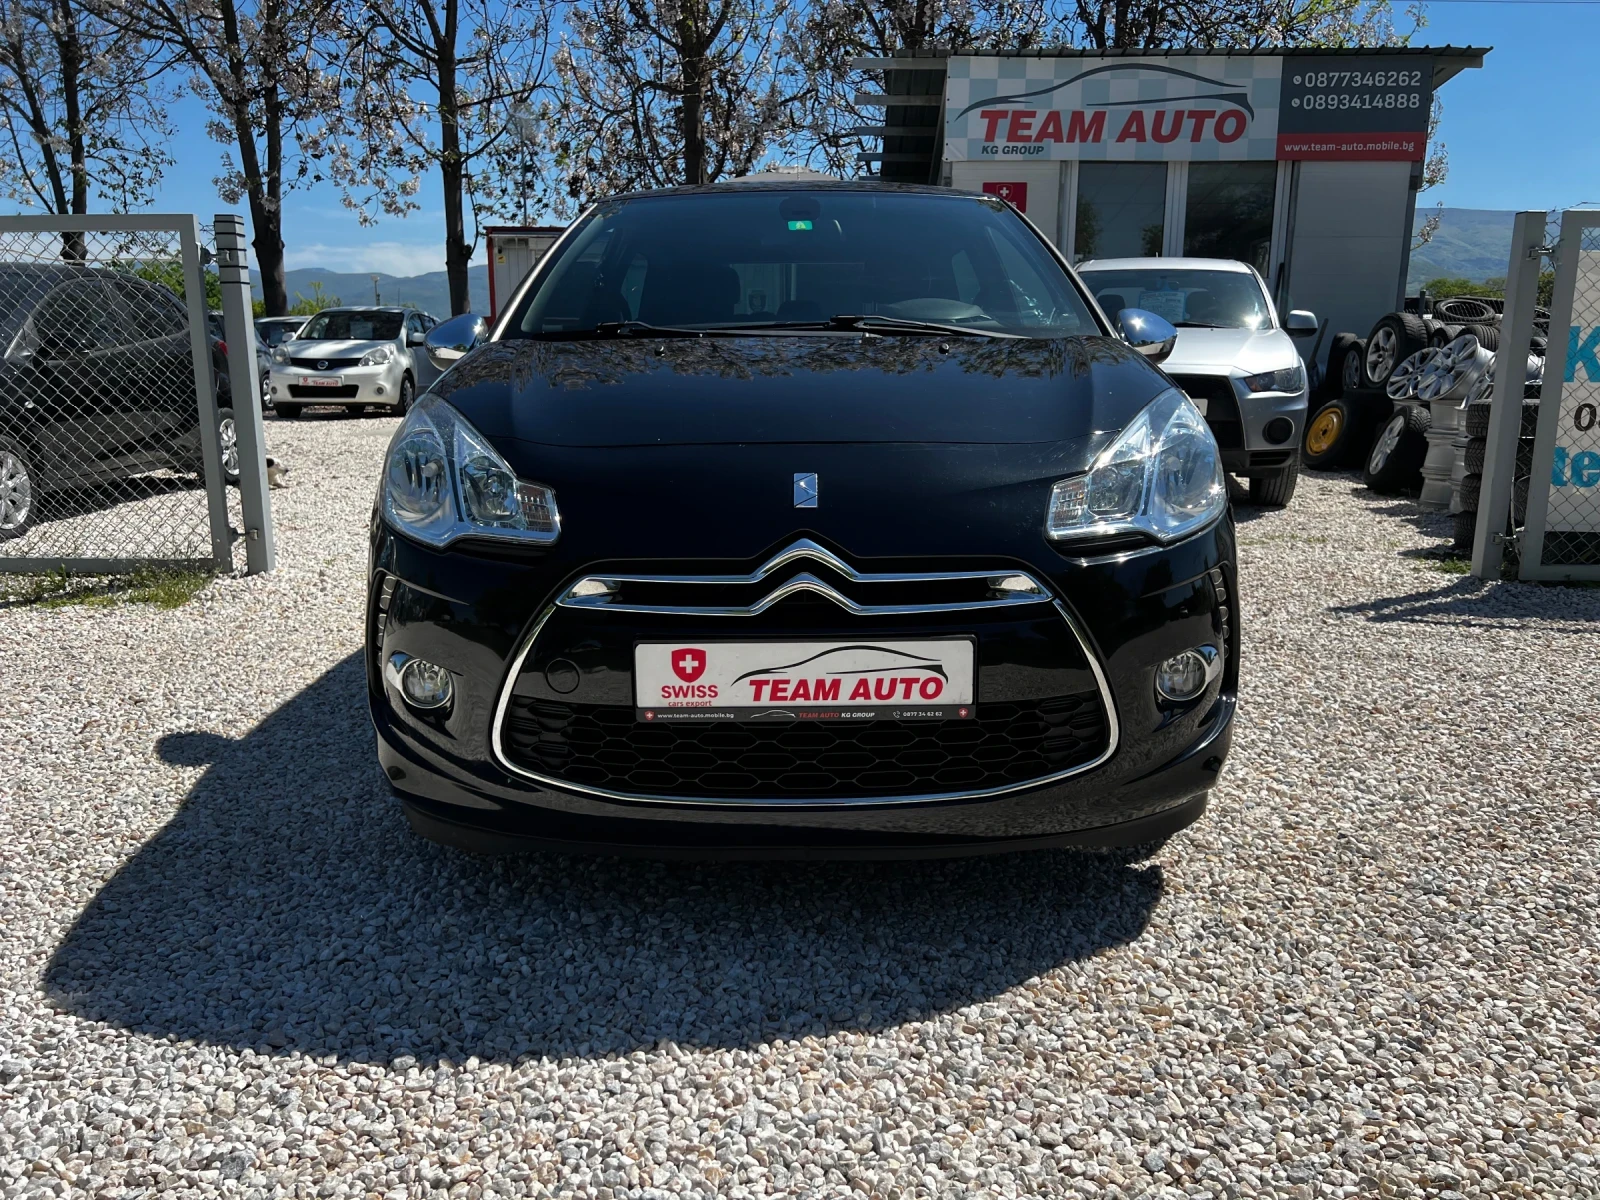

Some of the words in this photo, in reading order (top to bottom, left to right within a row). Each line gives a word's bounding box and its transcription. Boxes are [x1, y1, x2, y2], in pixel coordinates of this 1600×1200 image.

[1305, 71, 1421, 87] 0877346262
[1303, 93, 1420, 109] 0893414888
[980, 110, 1107, 143] TEAM
[1116, 109, 1247, 143] AUTO
[981, 145, 999, 155] KG
[1002, 145, 1044, 155] GROUP
[1284, 141, 1415, 152] www.team-auto.mobile.bg
[661, 685, 718, 698] SWISS
[749, 679, 841, 701] TEAM
[848, 676, 944, 701] AUTO
